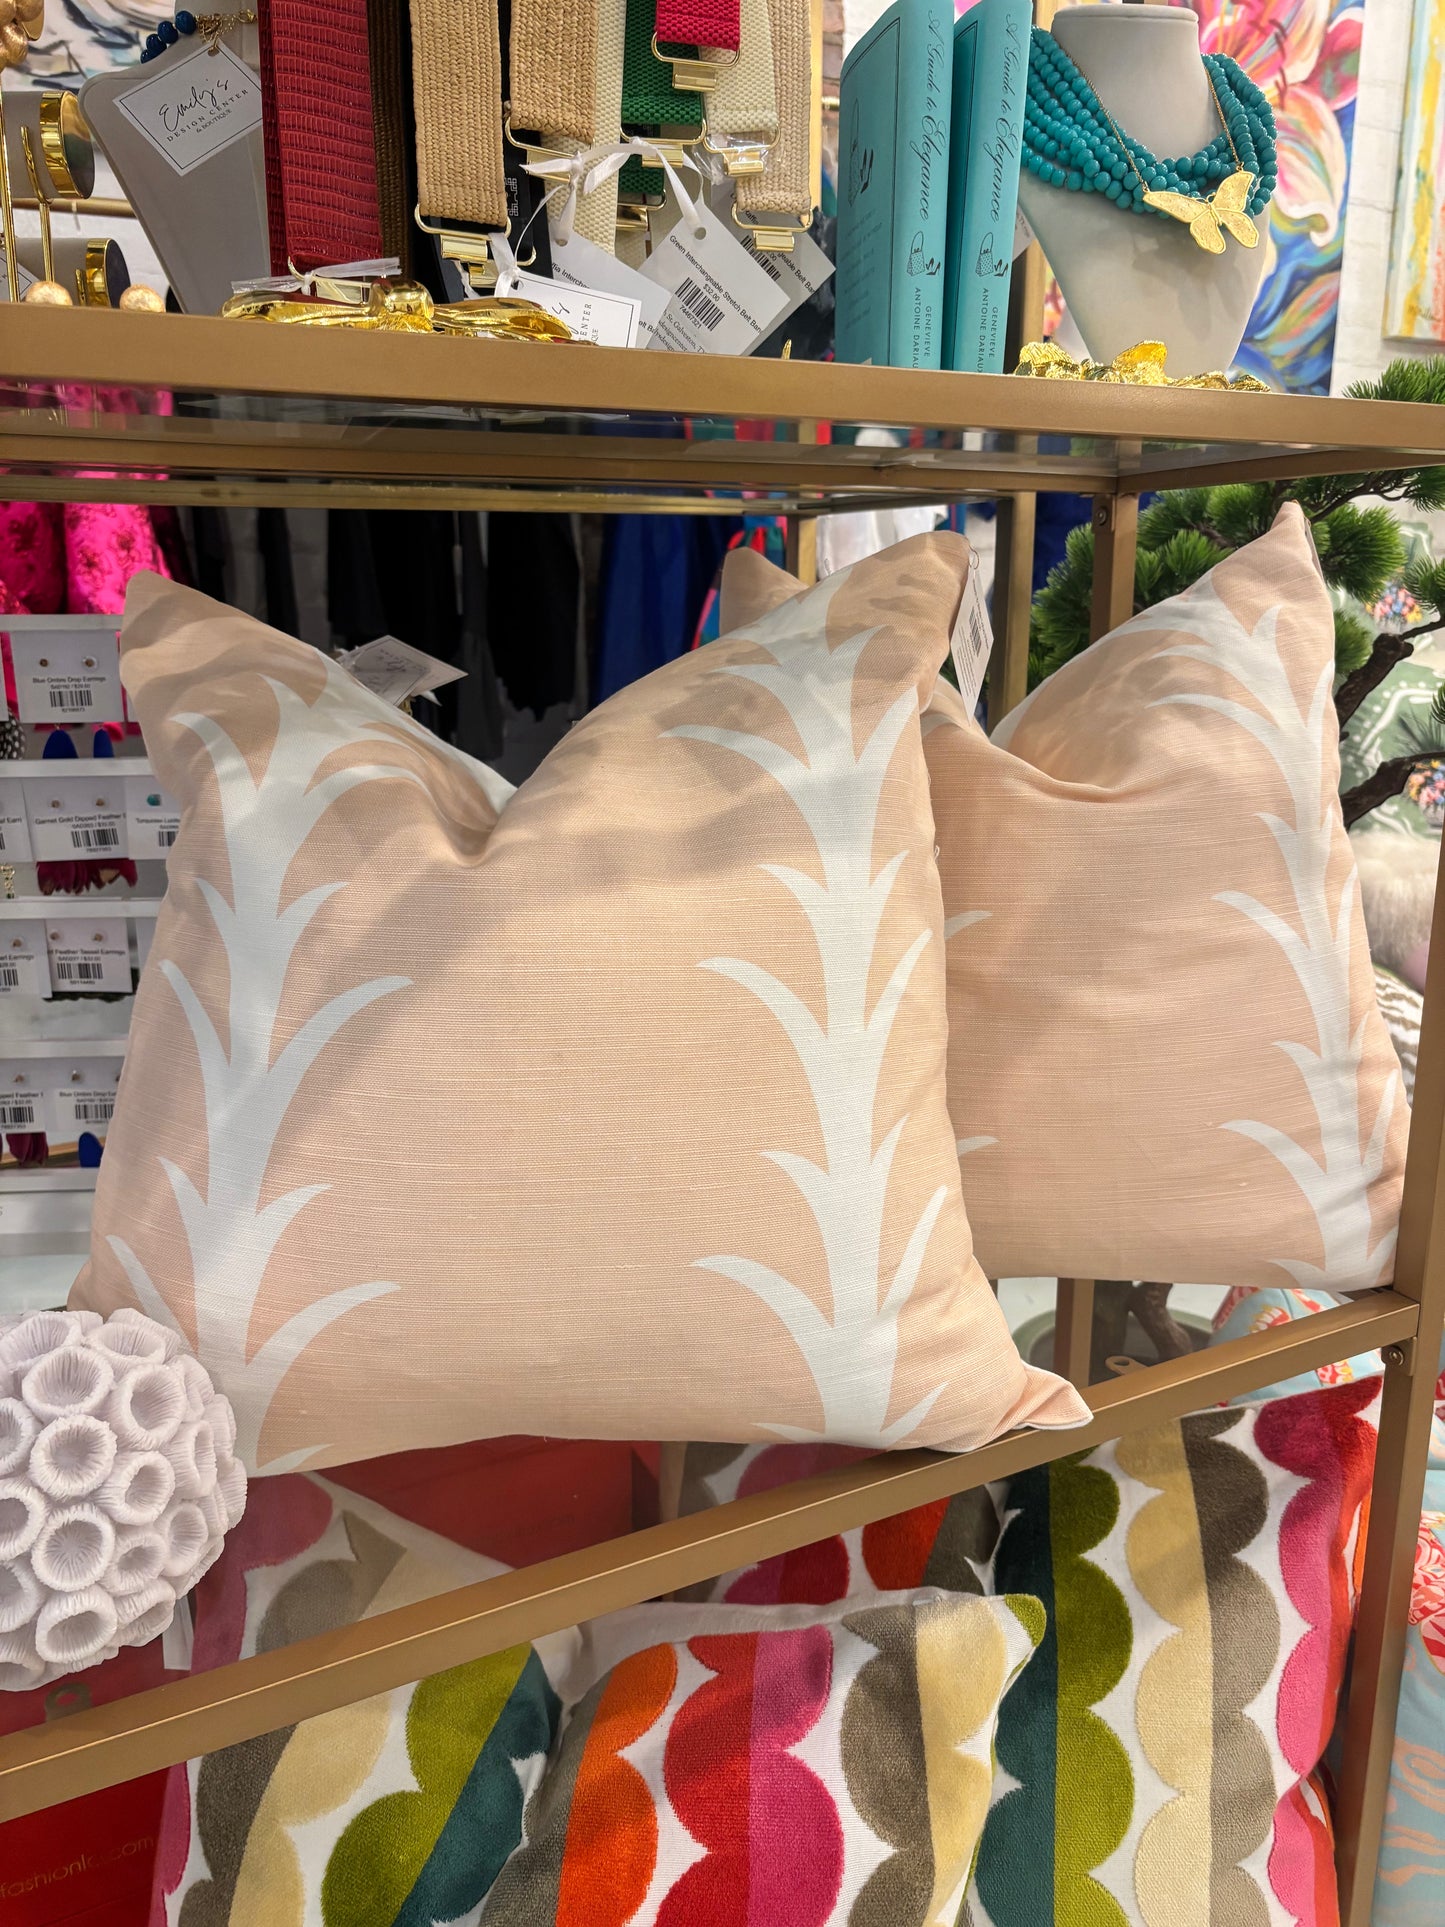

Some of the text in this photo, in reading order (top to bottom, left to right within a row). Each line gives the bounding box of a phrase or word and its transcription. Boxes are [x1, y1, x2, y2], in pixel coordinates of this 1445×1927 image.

[926, 43, 945, 93] Guide
[1003, 47, 1021, 96] Guide
[159, 78, 229, 132] Emily's
[166, 89, 249, 142] DESIGN CENTER
[202, 109, 232, 129] BOUTIQUE
[926, 96, 938, 111] to
[1000, 99, 1012, 113] to
[909, 115, 947, 221] Elegance
[982, 117, 1020, 223] Elegance
[669, 235, 686, 255] Green
[685, 251, 724, 294] Interchangeable
[722, 291, 741, 312] Stretch
[740, 308, 752, 323] Belt
[703, 283, 720, 302] $32.00
[679, 305, 702, 329] 74467321
[913, 287, 921, 330] ANTOINE
[923, 305, 932, 357] GENEVIEVE
[980, 288, 989, 330] ANTOINE
[988, 306, 998, 358] GENEVIEVE
[35, 817, 57, 825] Garnet
[59, 815, 73, 824] Gold
[75, 815, 97, 824] Dipped
[98, 813, 121, 822] Feather
